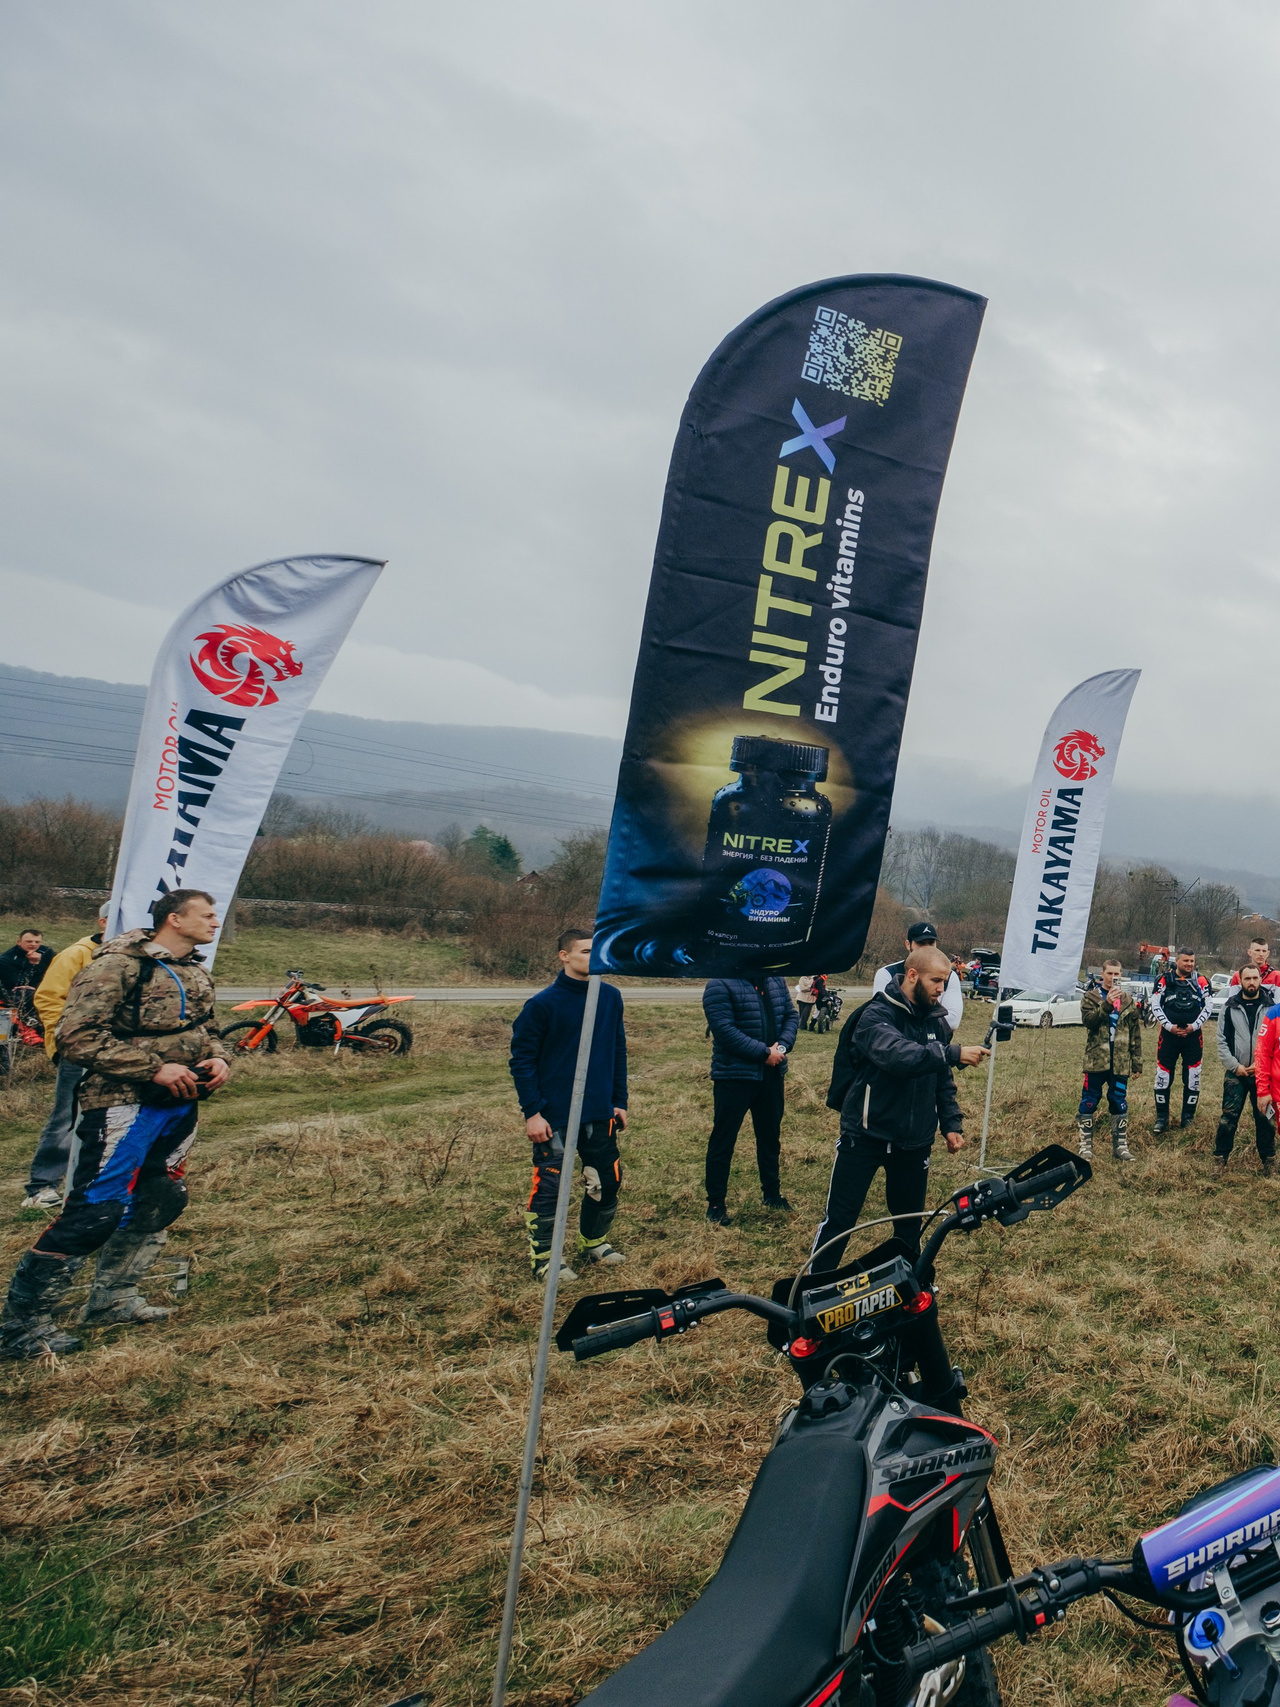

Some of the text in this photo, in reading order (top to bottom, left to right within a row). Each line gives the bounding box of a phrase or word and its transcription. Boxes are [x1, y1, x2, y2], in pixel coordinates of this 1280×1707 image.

[743, 397, 847, 716] NITREX
[815, 487, 865, 723] Enduro vitamins
[153, 735, 179, 811] MOTOR
[723, 832, 810, 854] NITREX
[1031, 787, 1053, 854] MOTOR OIL
[722, 850, 754, 860] ЭНЕРГИЯ
[774, 856, 808, 864] ПАДЕНИЙ
[1030, 787, 1084, 955] TAKAYAMA
[748, 915, 791, 923] ВИТАМИНЫ
[749, 908, 780, 916] ЭНДУРО
[824, 1287, 895, 1332] PROTAPER
[879, 1443, 992, 1486] SHARMAX
